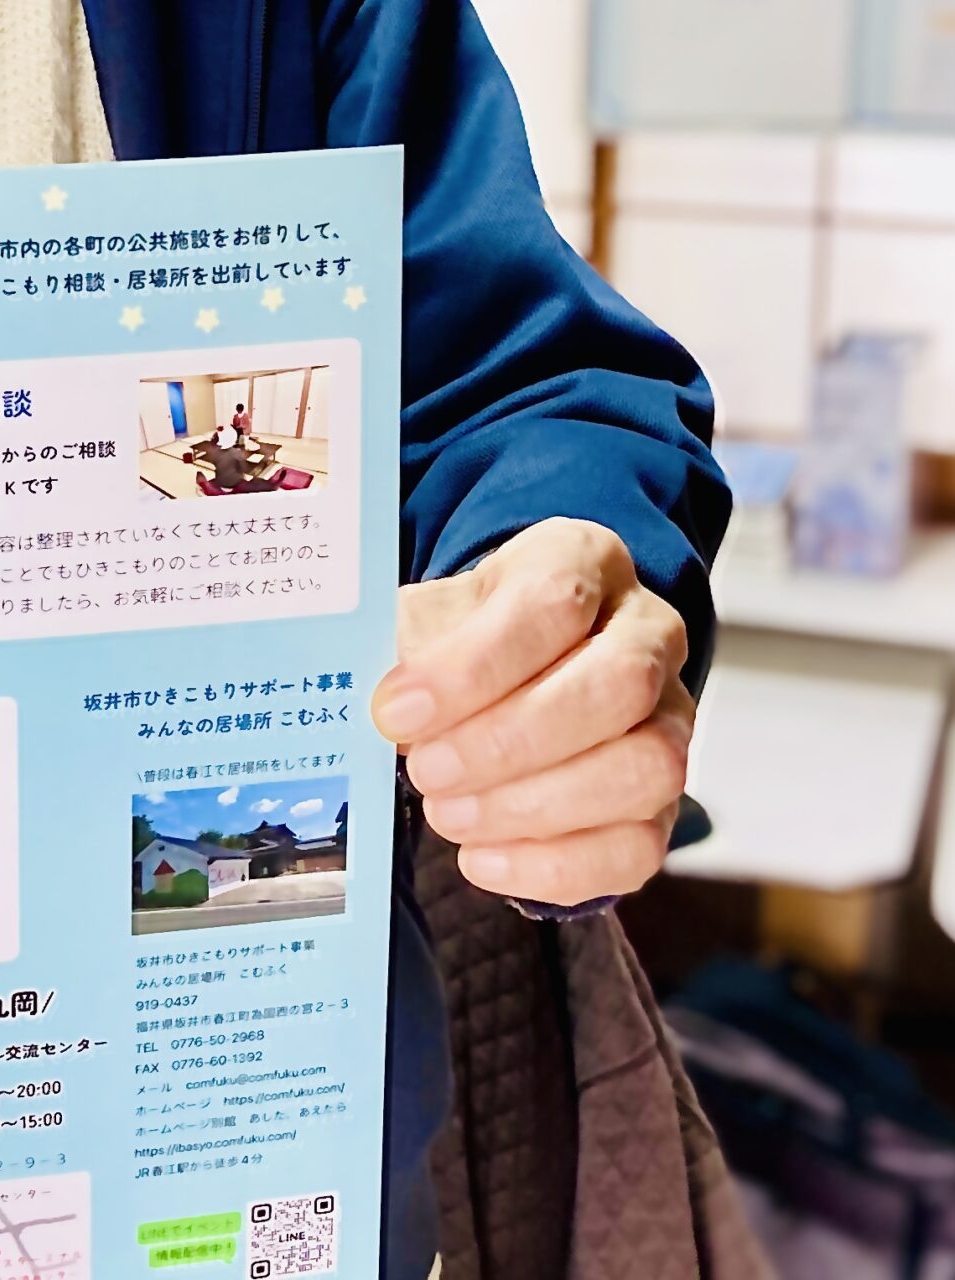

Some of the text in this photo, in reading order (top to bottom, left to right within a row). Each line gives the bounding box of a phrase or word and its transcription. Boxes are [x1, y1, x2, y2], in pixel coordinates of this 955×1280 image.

[84, 671, 354, 712] 坂井市ひきこもりサポート事業
[137, 705, 349, 739] みんなの居場所 こむふく
[136, 940, 315, 969] 坂井市ひきこもりサポート事業
[135, 995, 198, 1012] 919-0437
[136, 1041, 158, 1054] TEL
[135, 1062, 159, 1075] FAX
[137, 1083, 172, 1095] メール
[278, 1232, 306, 1243] LINE
